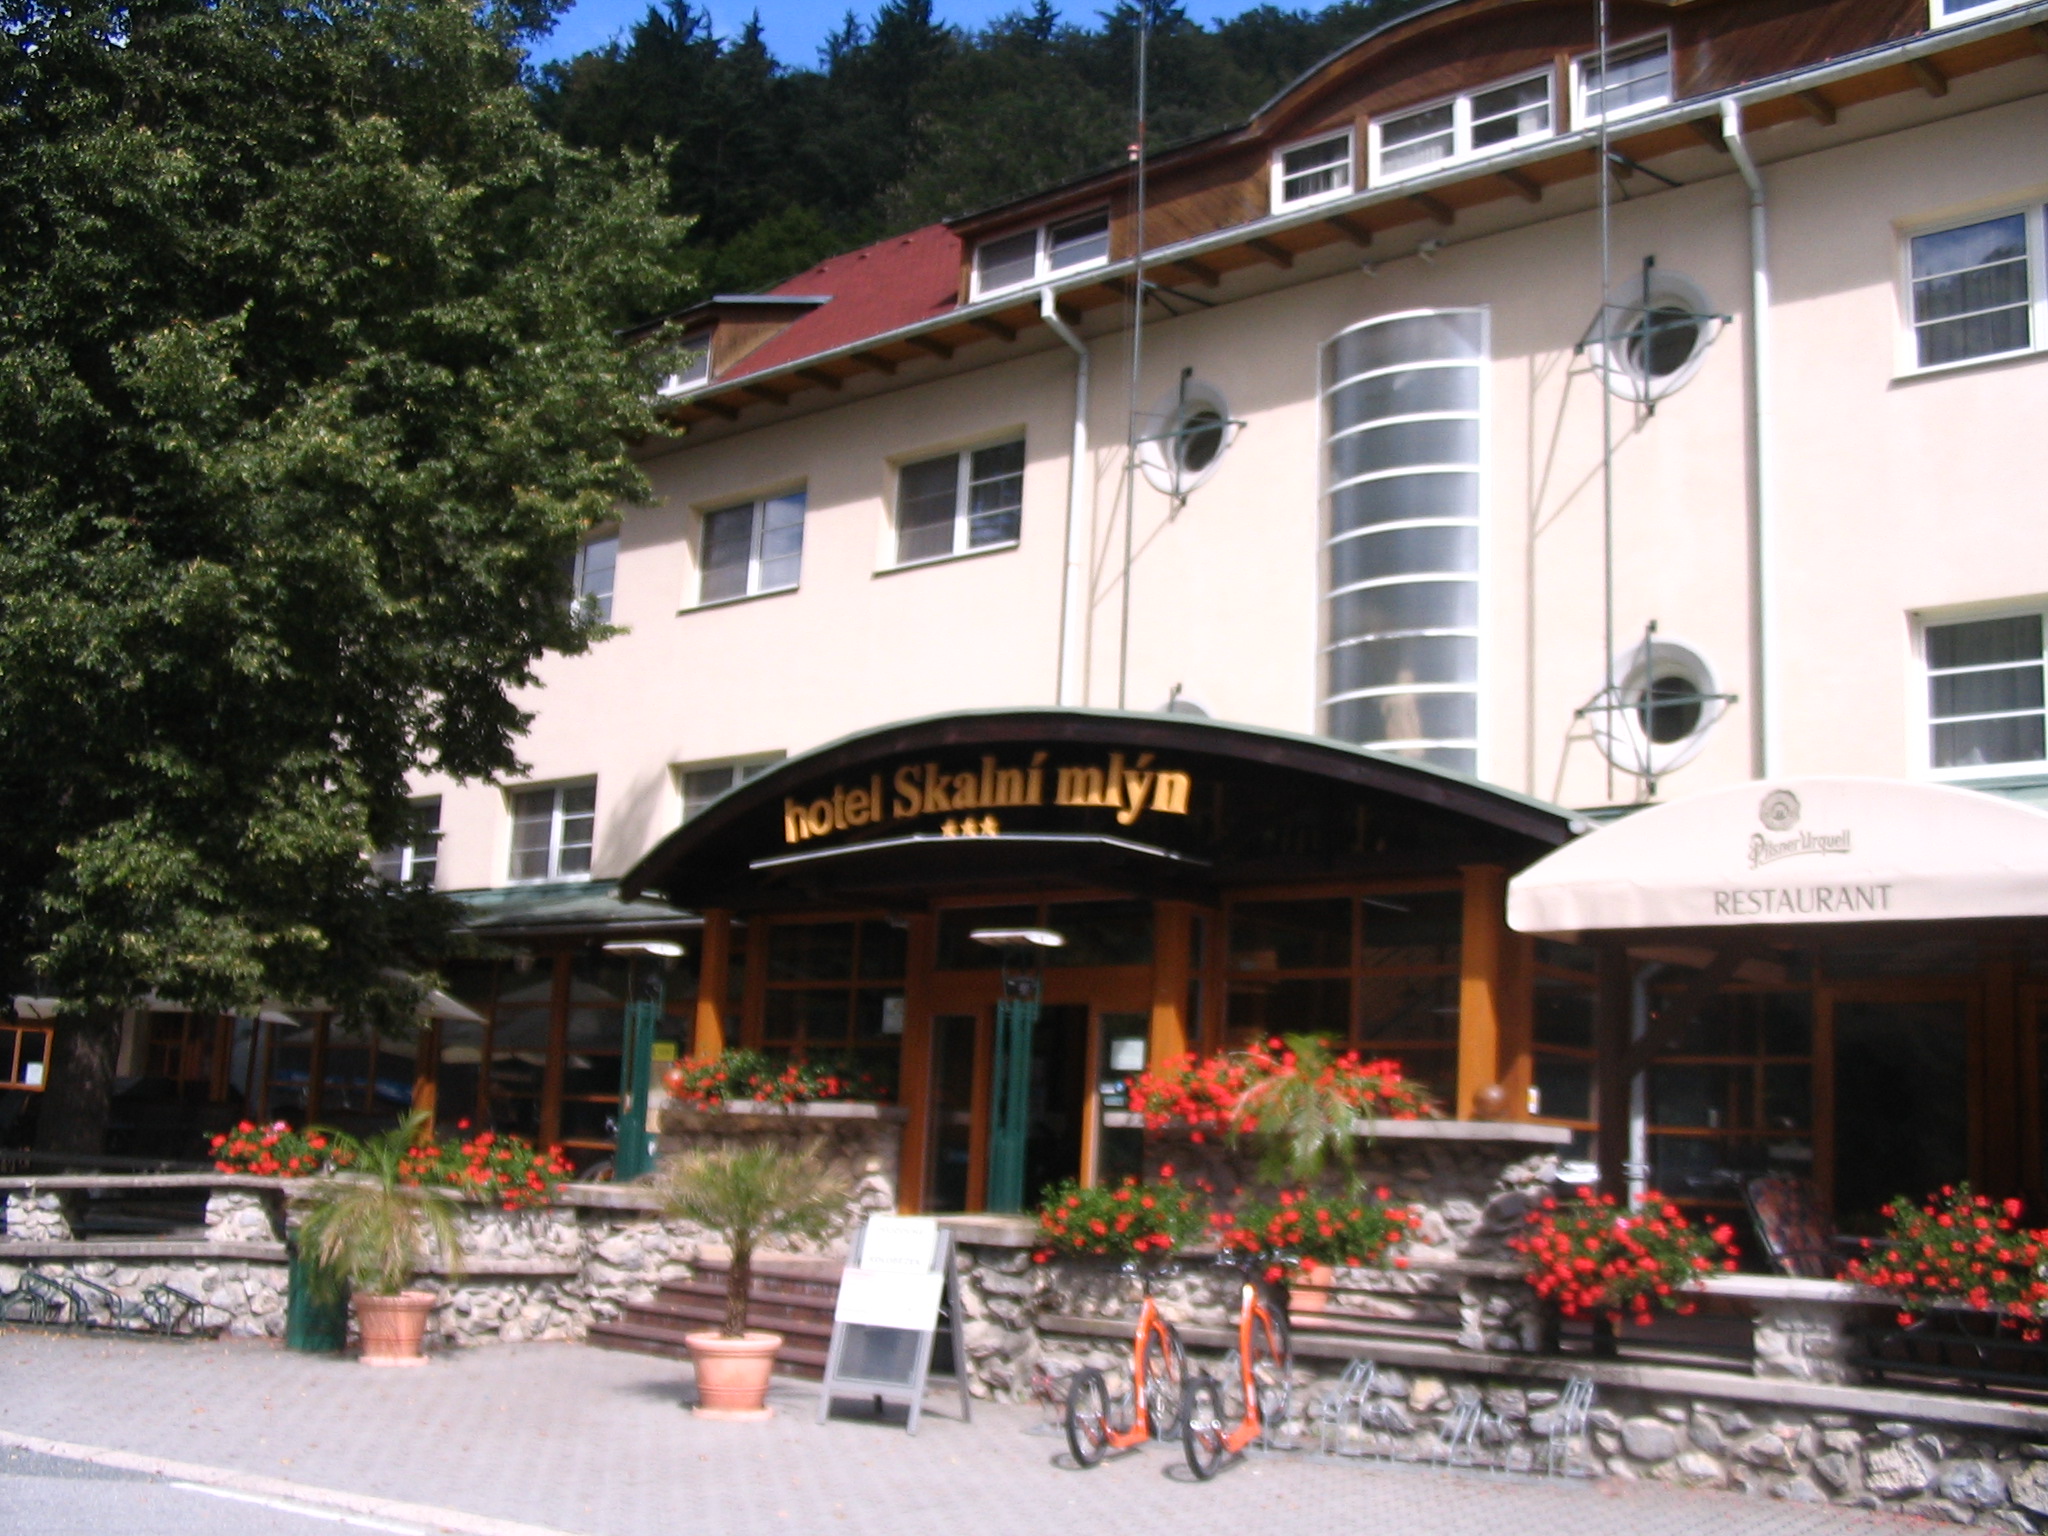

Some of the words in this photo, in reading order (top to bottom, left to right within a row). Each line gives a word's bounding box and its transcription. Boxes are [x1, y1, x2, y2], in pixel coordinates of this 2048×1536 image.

[784, 773, 881, 844] hotel
[892, 751, 1050, 818] Skalní
[1054, 752, 1193, 827] mlýn
[1748, 832, 1800, 870] Pilsner
[1799, 829, 1851, 856] Urquell
[1714, 885, 1892, 915] RESTAURANT
